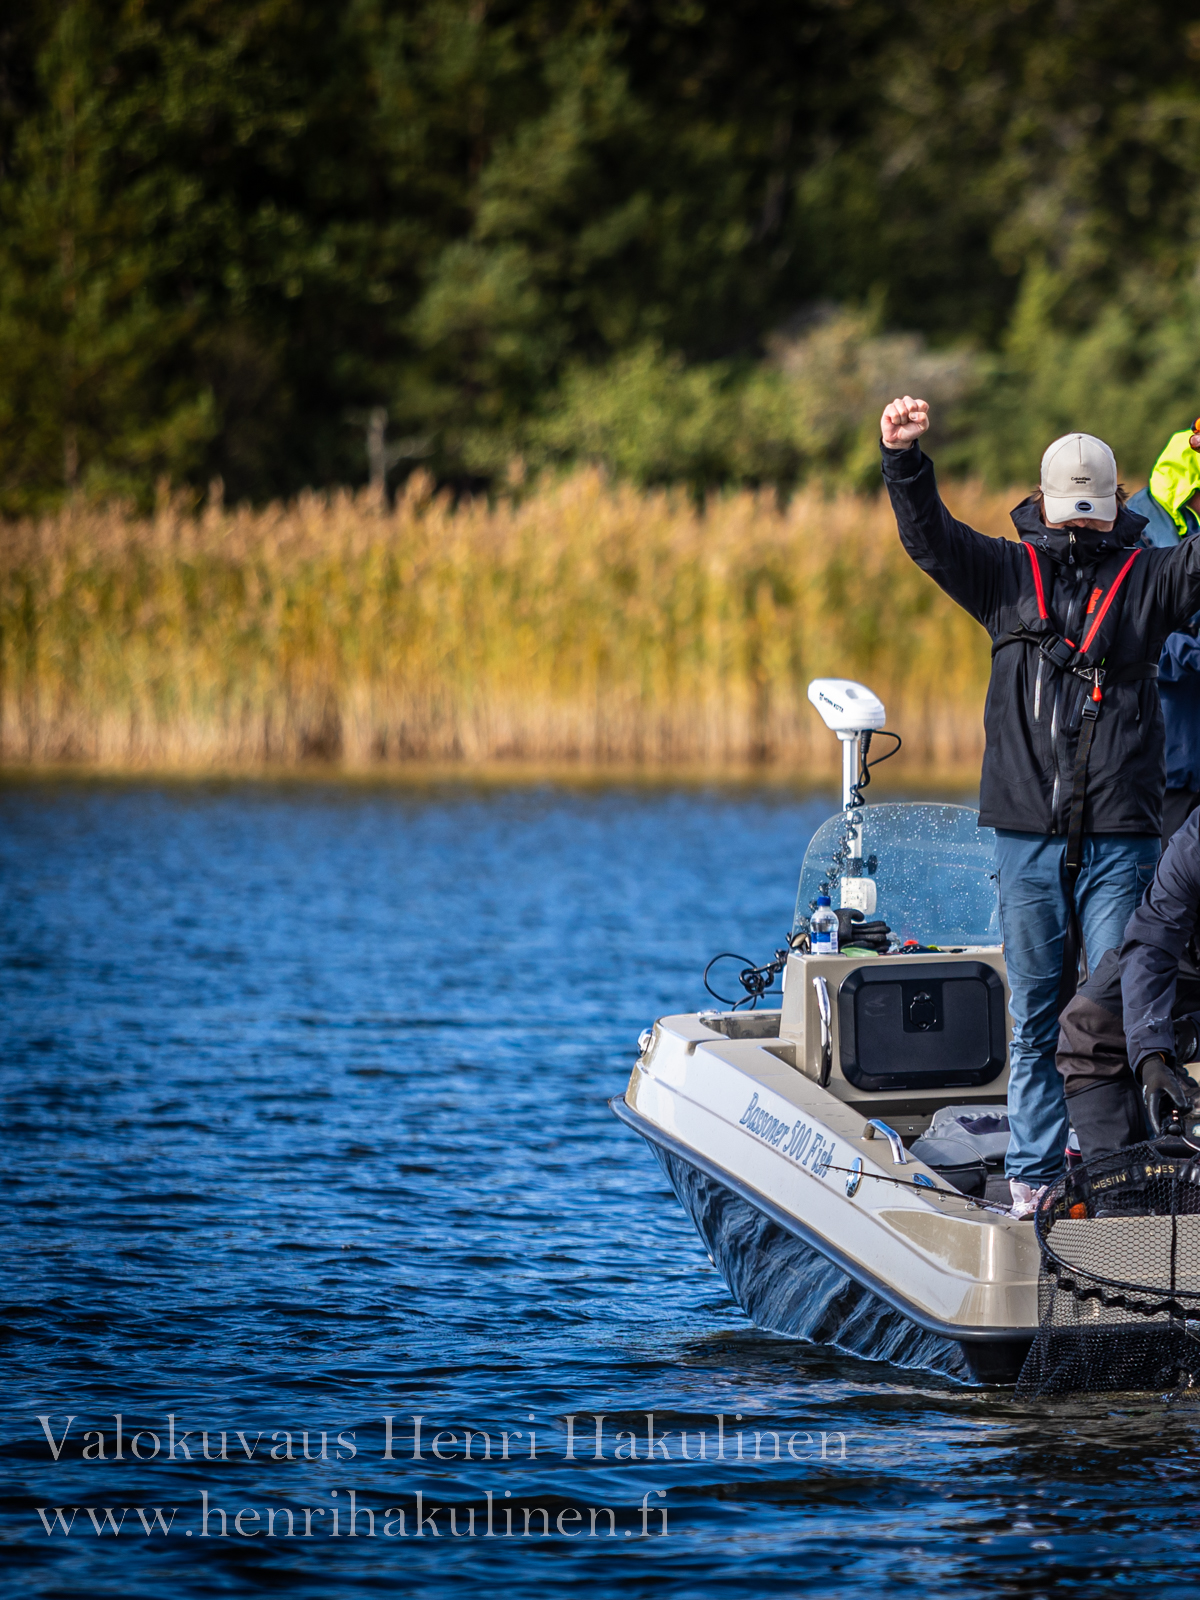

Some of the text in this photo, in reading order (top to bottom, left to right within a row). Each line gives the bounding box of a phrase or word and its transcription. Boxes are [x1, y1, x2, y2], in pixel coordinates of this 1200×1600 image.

[739, 1092, 836, 1179] Bassoner 500 Fish
[1092, 1174, 1126, 1190] WESTIN
